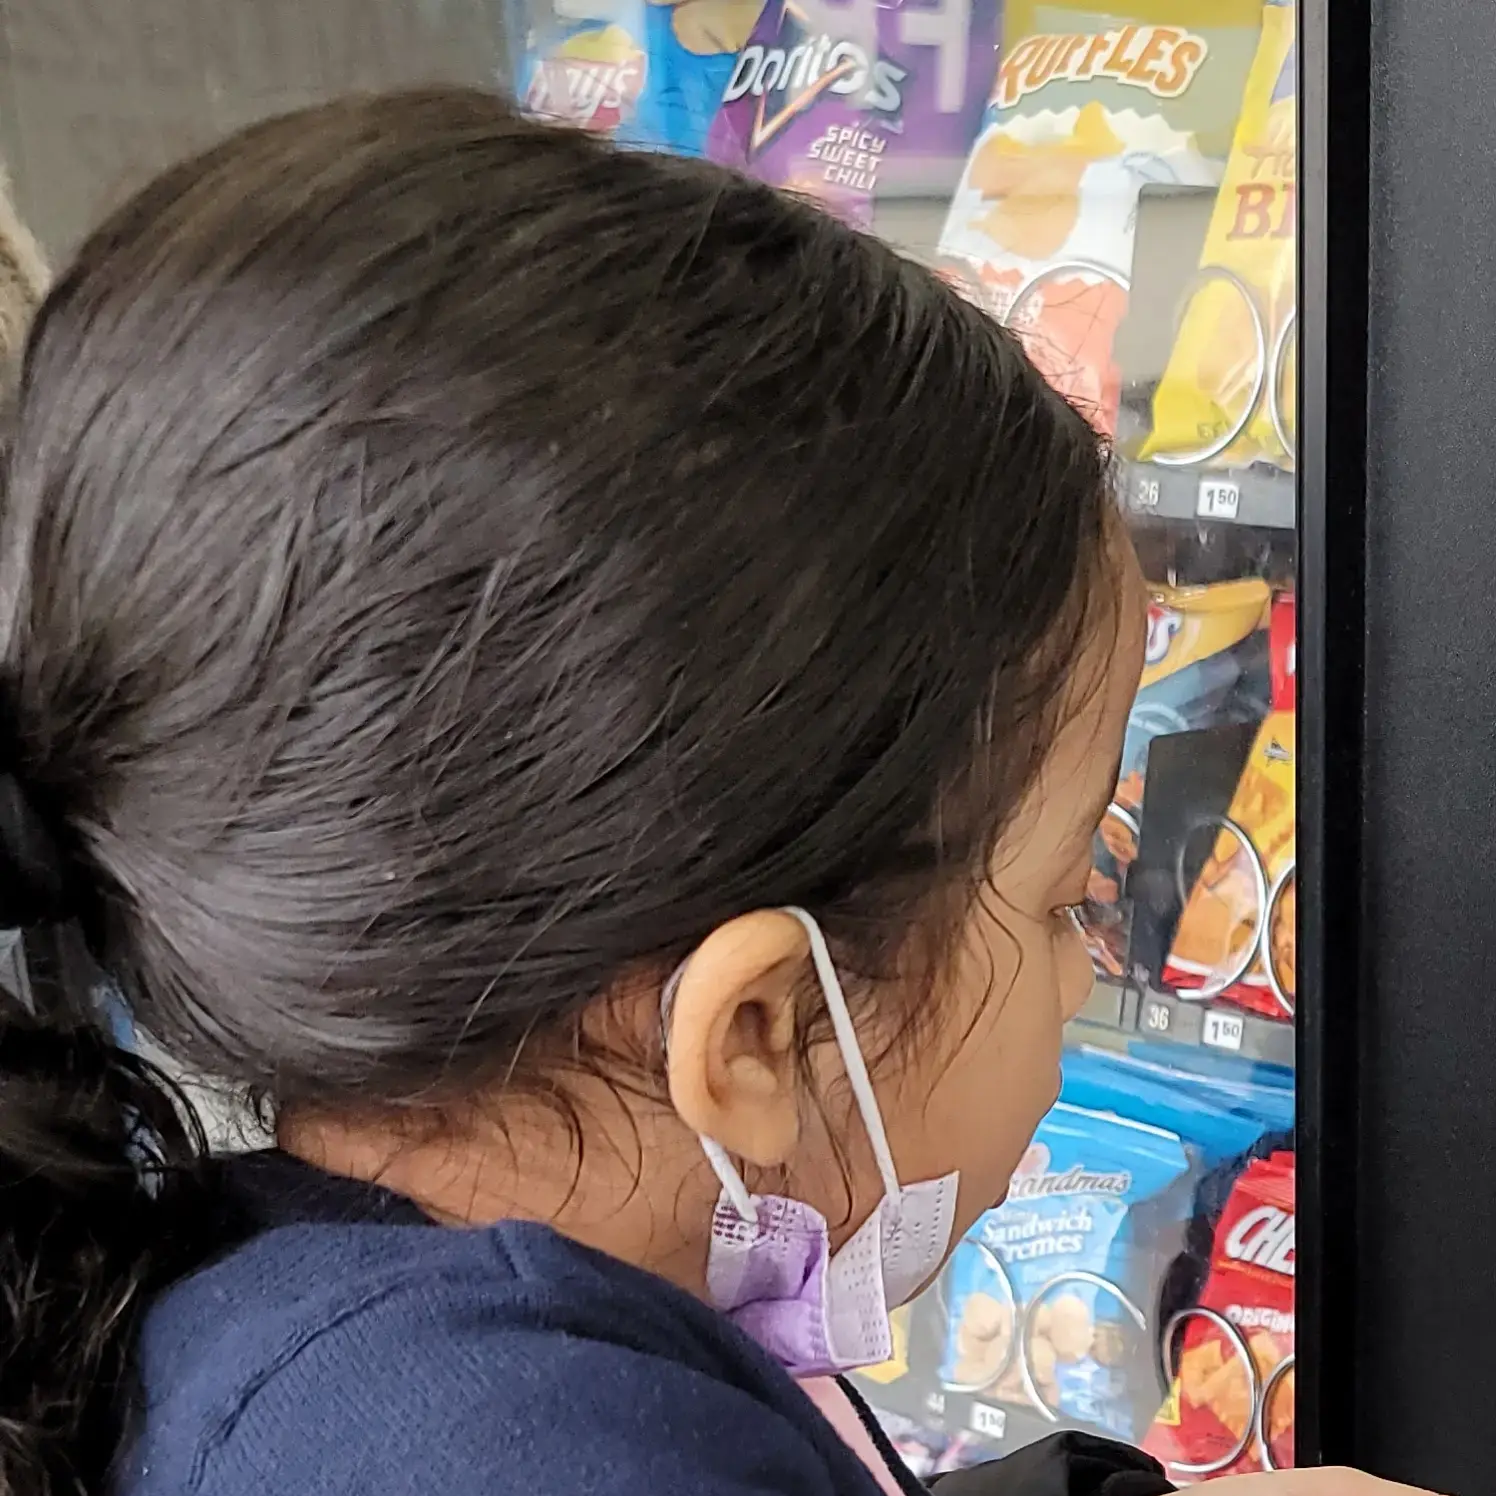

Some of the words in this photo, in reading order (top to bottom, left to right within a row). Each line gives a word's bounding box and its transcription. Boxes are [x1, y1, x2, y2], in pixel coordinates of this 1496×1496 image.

[722, 34, 907, 112] Doritos
[1000, 24, 1206, 106] RUFFLES
[807, 136, 882, 172] SWEET
[826, 124, 887, 152] SPICY
[823, 165, 876, 190] CHILI
[1149, 1005, 1169, 1031] 36
[984, 1206, 1092, 1241] Sandwich
